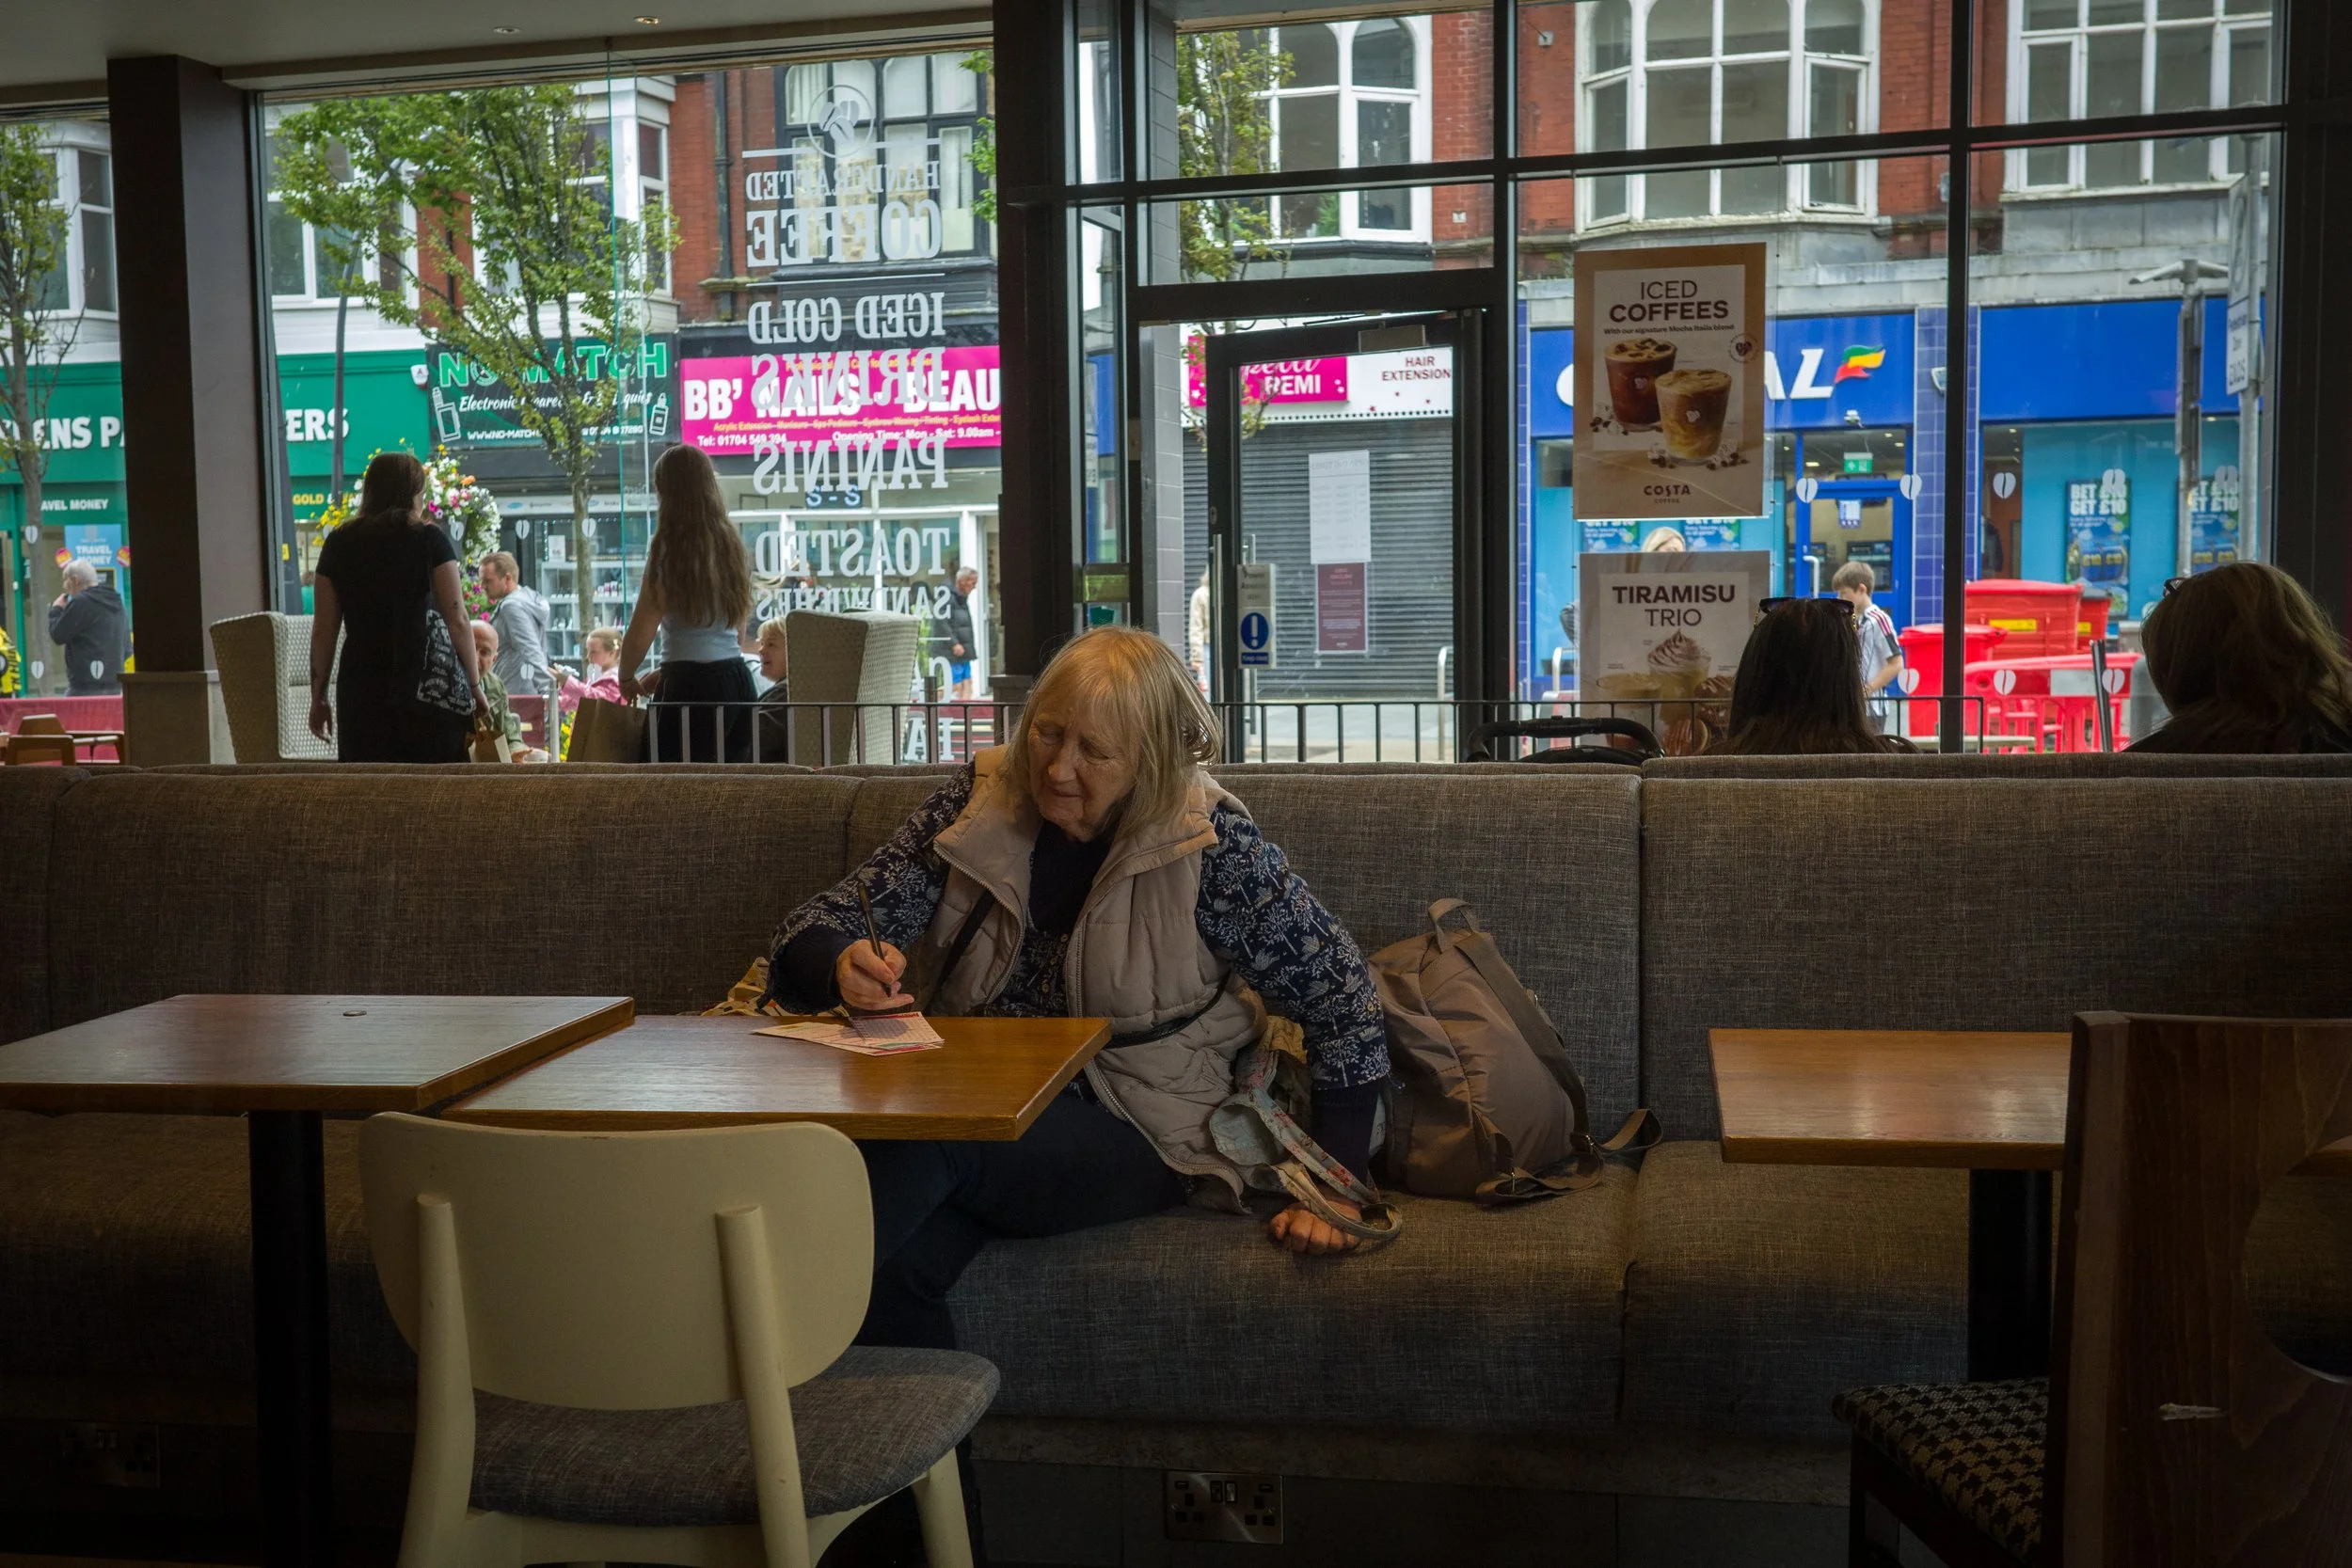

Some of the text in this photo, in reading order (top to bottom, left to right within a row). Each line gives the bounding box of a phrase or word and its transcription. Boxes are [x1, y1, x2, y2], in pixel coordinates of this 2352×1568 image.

[1640, 280, 1697, 300] ICED
[1609, 300, 1729, 323] COFFEES
[1406, 356, 1435, 367] HAIR
[1264, 373, 1321, 395] REMI
[459, 395, 518, 412] Electronic
[697, 436, 716, 447] Tel:
[1644, 484, 1692, 497] COSTA
[40, 499, 109, 512] AVEL MONEY
[293, 494, 325, 504] GOLD
[76, 545, 111, 555] TRAVEL
[1612, 584, 1736, 604] TIRAMISU
[1645, 608, 1702, 627] TRIO
